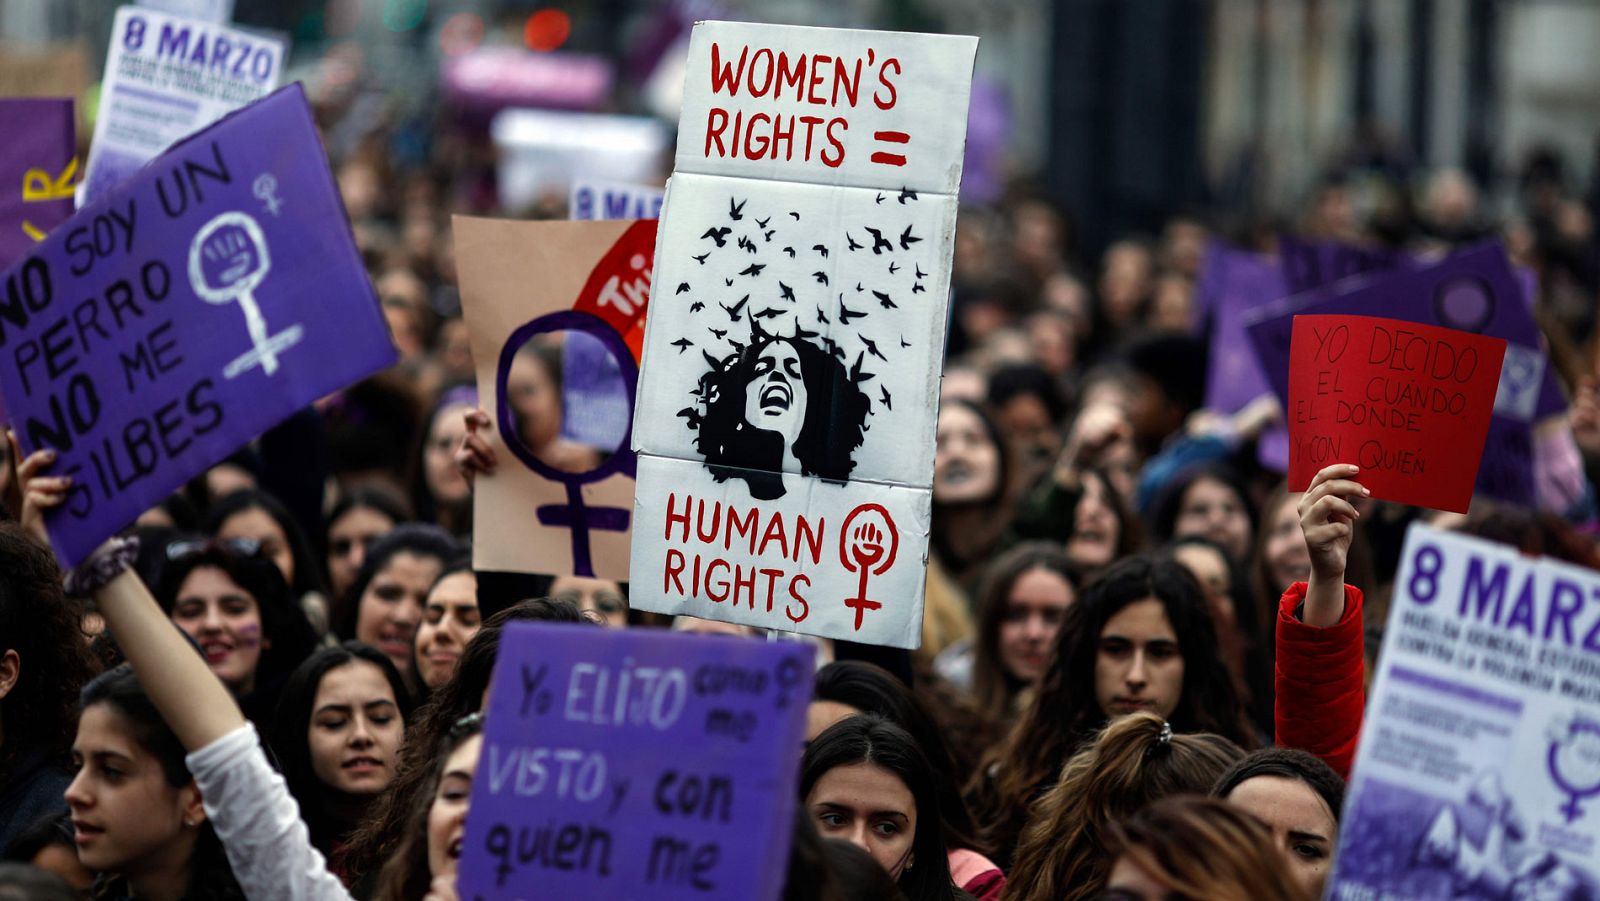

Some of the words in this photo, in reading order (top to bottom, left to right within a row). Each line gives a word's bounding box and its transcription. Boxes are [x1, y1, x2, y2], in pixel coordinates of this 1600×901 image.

[123, 16, 147, 52] 8
[158, 22, 274, 85] MARZO
[711, 42, 901, 110] WOMEN'S
[704, 107, 848, 168] RIGHTS
[0, 255, 52, 347] NO
[64, 201, 137, 278] SOY
[154, 140, 232, 218] UN
[14, 259, 171, 397] PERRO
[1313, 325, 1349, 363] YO
[1368, 326, 1478, 383] DECIDO
[26, 373, 102, 454] NO
[118, 319, 184, 394] ME
[1297, 400, 1317, 424] EL
[1317, 370, 1344, 395] EL
[65, 378, 225, 519] SILBES
[1309, 435, 1342, 463] CON
[664, 492, 825, 565] HUMAN
[664, 548, 812, 623] RIGHTS
[1407, 544, 1445, 605] 8
[519, 664, 552, 716] Yo
[692, 663, 769, 696] como
[705, 706, 759, 744] me
[488, 745, 607, 801] VISTO
[654, 769, 735, 825] con
[485, 820, 614, 887] quien
[645, 836, 721, 891] me
